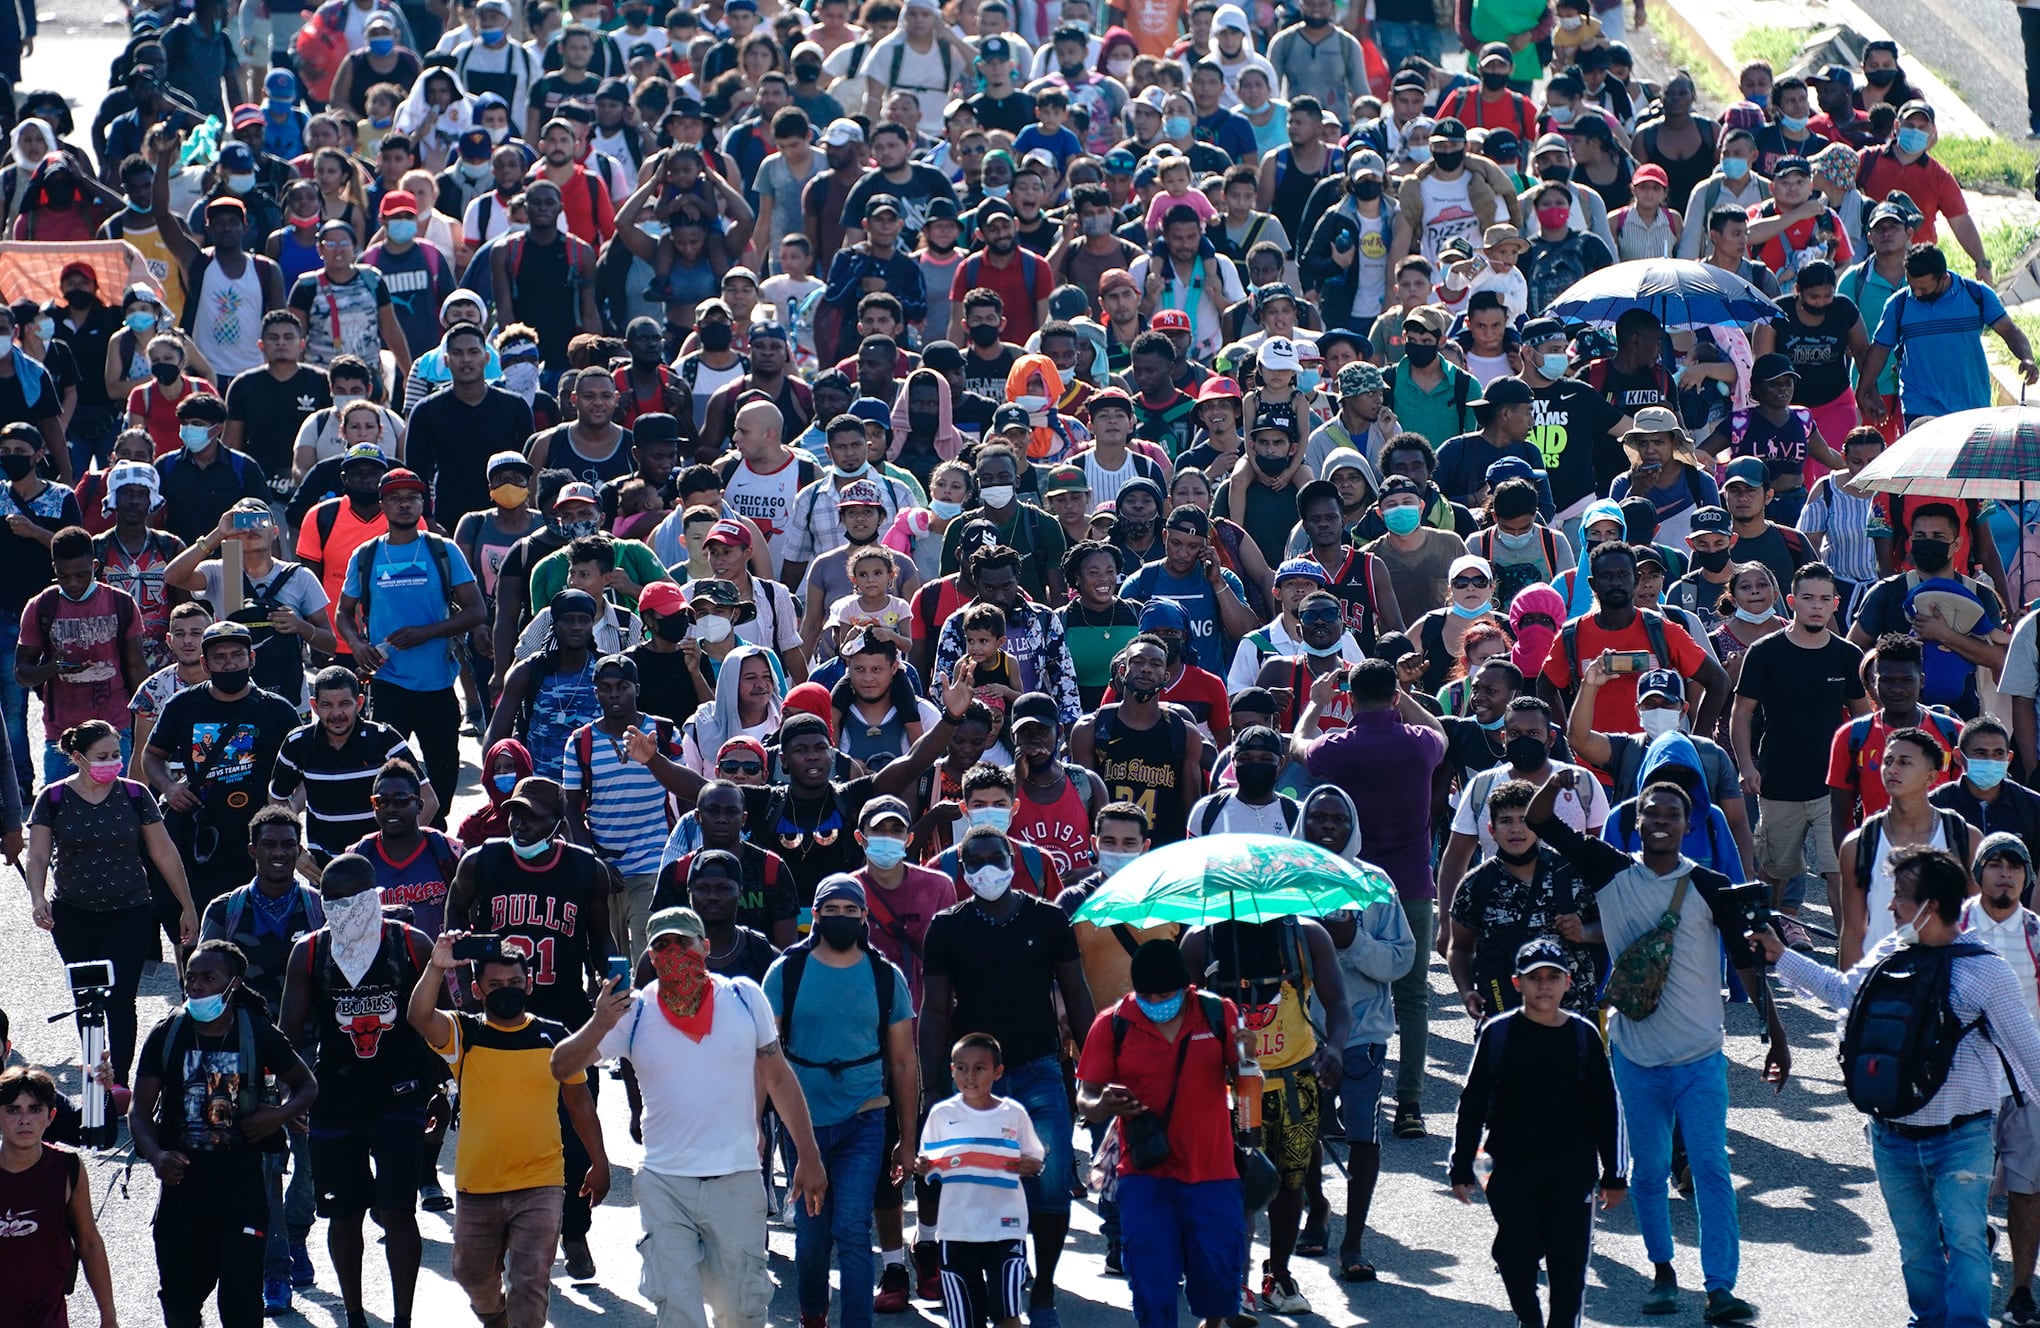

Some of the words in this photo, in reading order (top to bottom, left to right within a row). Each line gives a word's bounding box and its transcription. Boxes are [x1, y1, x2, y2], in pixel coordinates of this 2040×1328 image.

[1627, 390, 1658, 404] KING
[733, 494, 786, 507] CHICAGO
[739, 506, 776, 519] BULLS
[1007, 638, 1015, 653] A
[1104, 759, 1127, 782] Los
[1053, 821, 1090, 862] 1972
[491, 894, 578, 938] BULLS
[340, 996, 393, 1016] BULLS
[1256, 1032, 1285, 1059] LS
